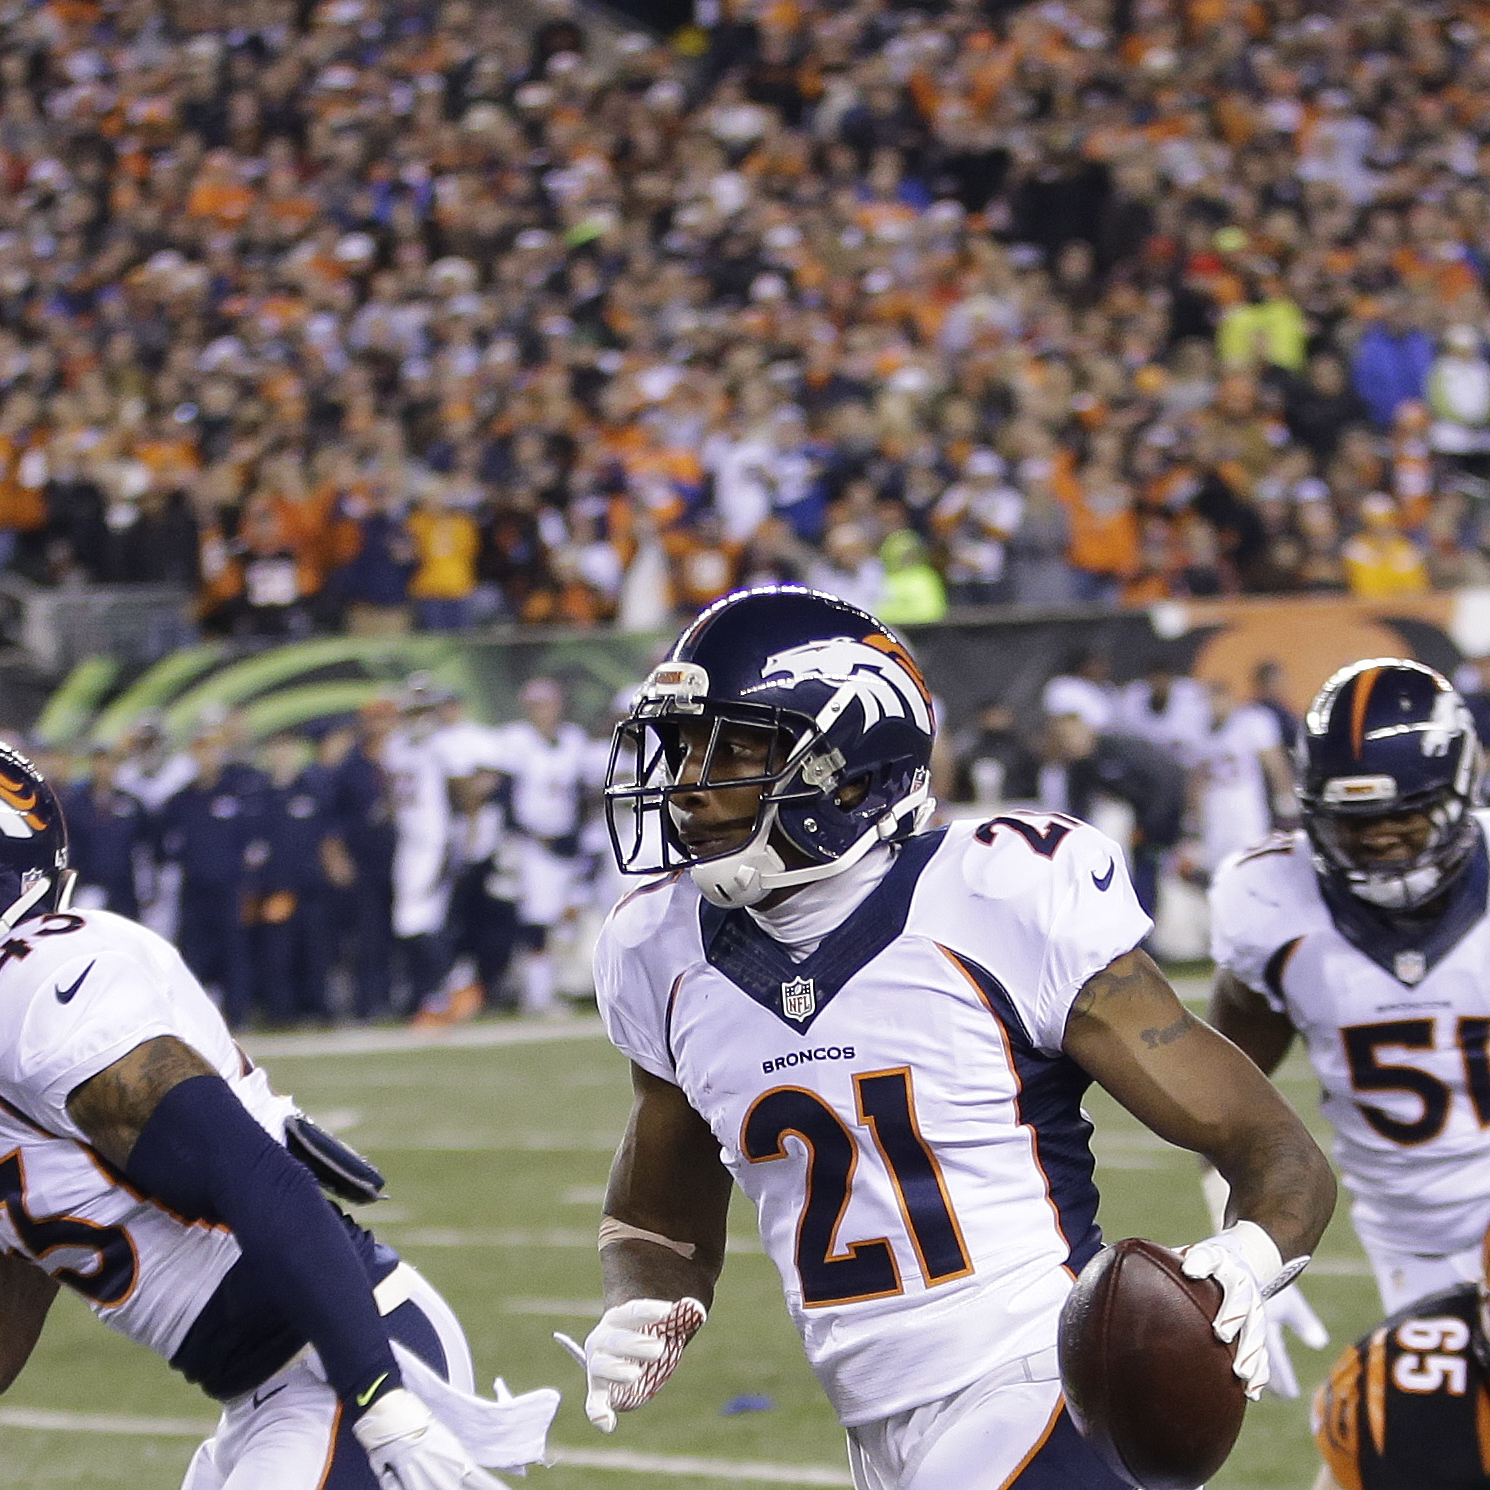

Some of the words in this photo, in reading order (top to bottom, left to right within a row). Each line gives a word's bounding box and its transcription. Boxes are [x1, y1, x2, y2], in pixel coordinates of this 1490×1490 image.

[788, 995, 812, 1014] NFL
[762, 1046, 856, 1075] BRONCOS
[740, 1065, 976, 1311] 21
[1394, 1314, 1471, 1398] 65
